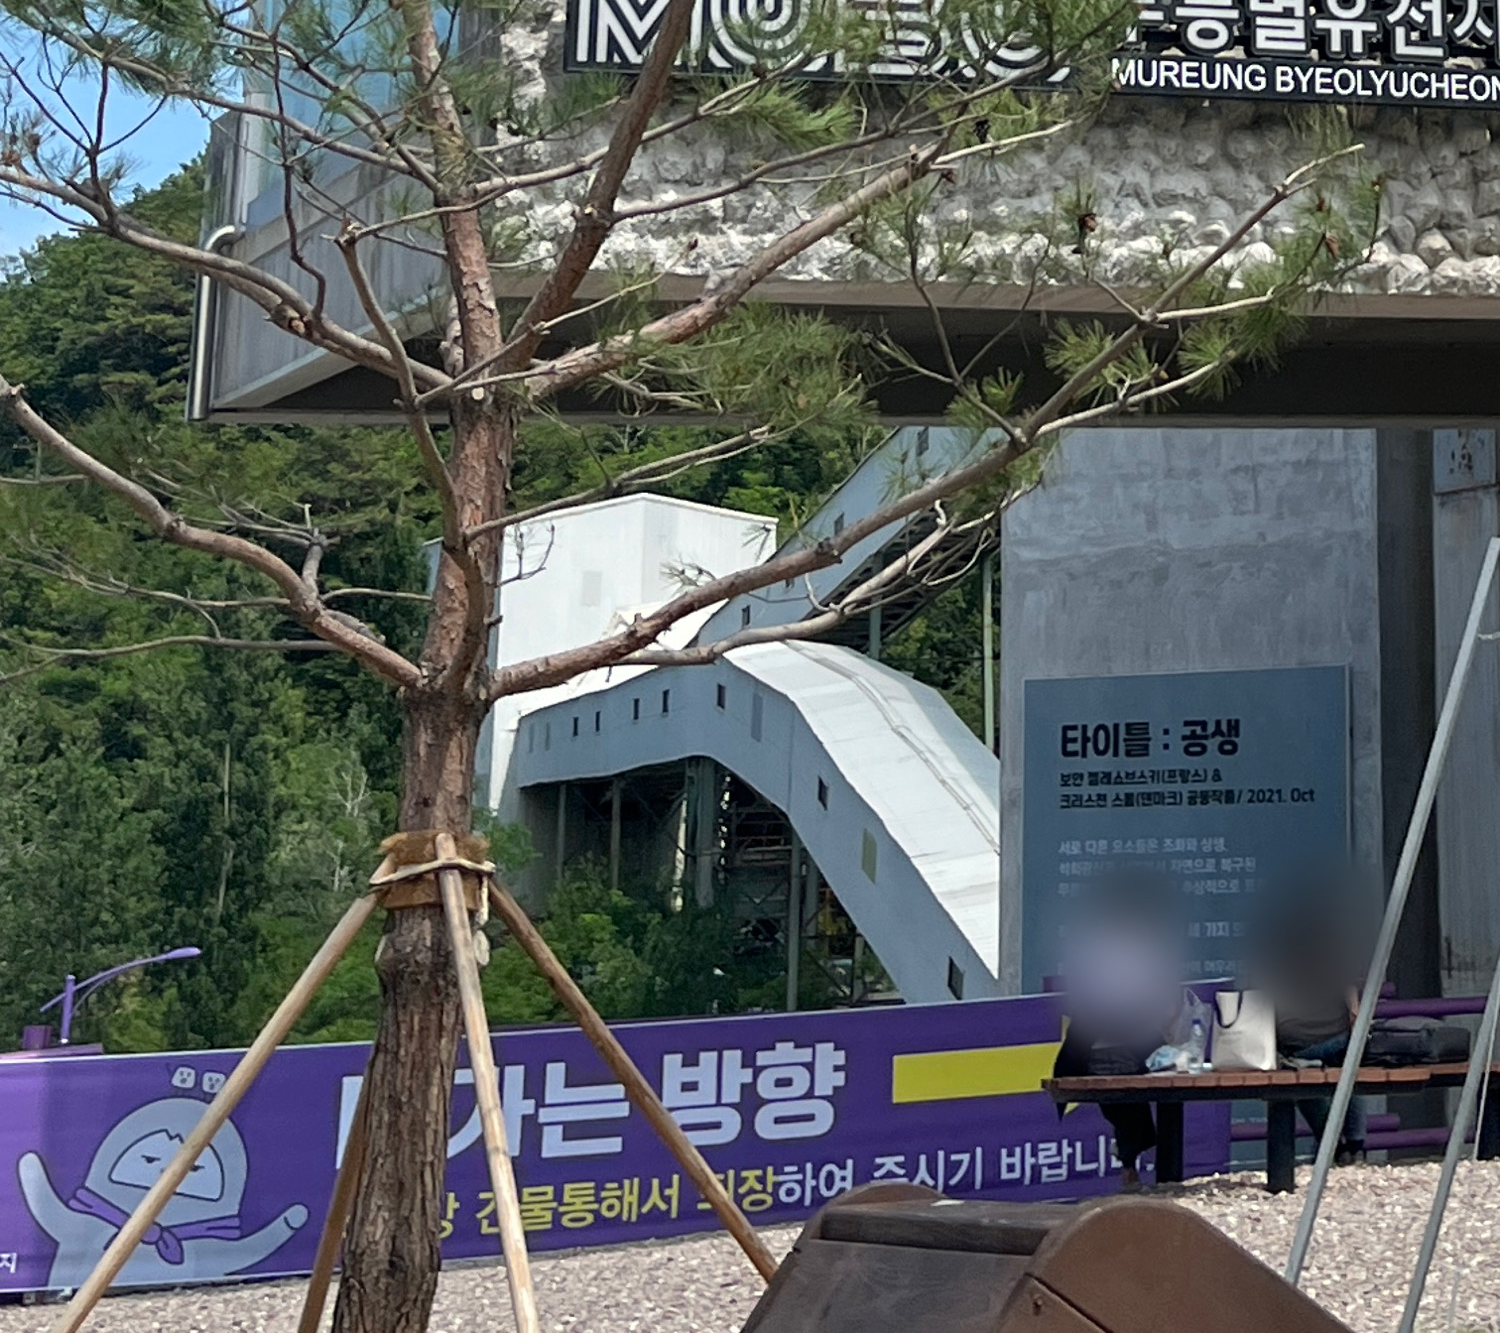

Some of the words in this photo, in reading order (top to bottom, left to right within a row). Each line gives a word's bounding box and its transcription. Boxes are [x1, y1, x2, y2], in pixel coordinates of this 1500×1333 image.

[1111, 57, 1267, 91] MUREUNG
[1061, 722, 1152, 759] 타이틀
[1181, 719, 1241, 757] 공생
[1290, 787, 1316, 803] Oct
[661, 1041, 847, 1147] 방향
